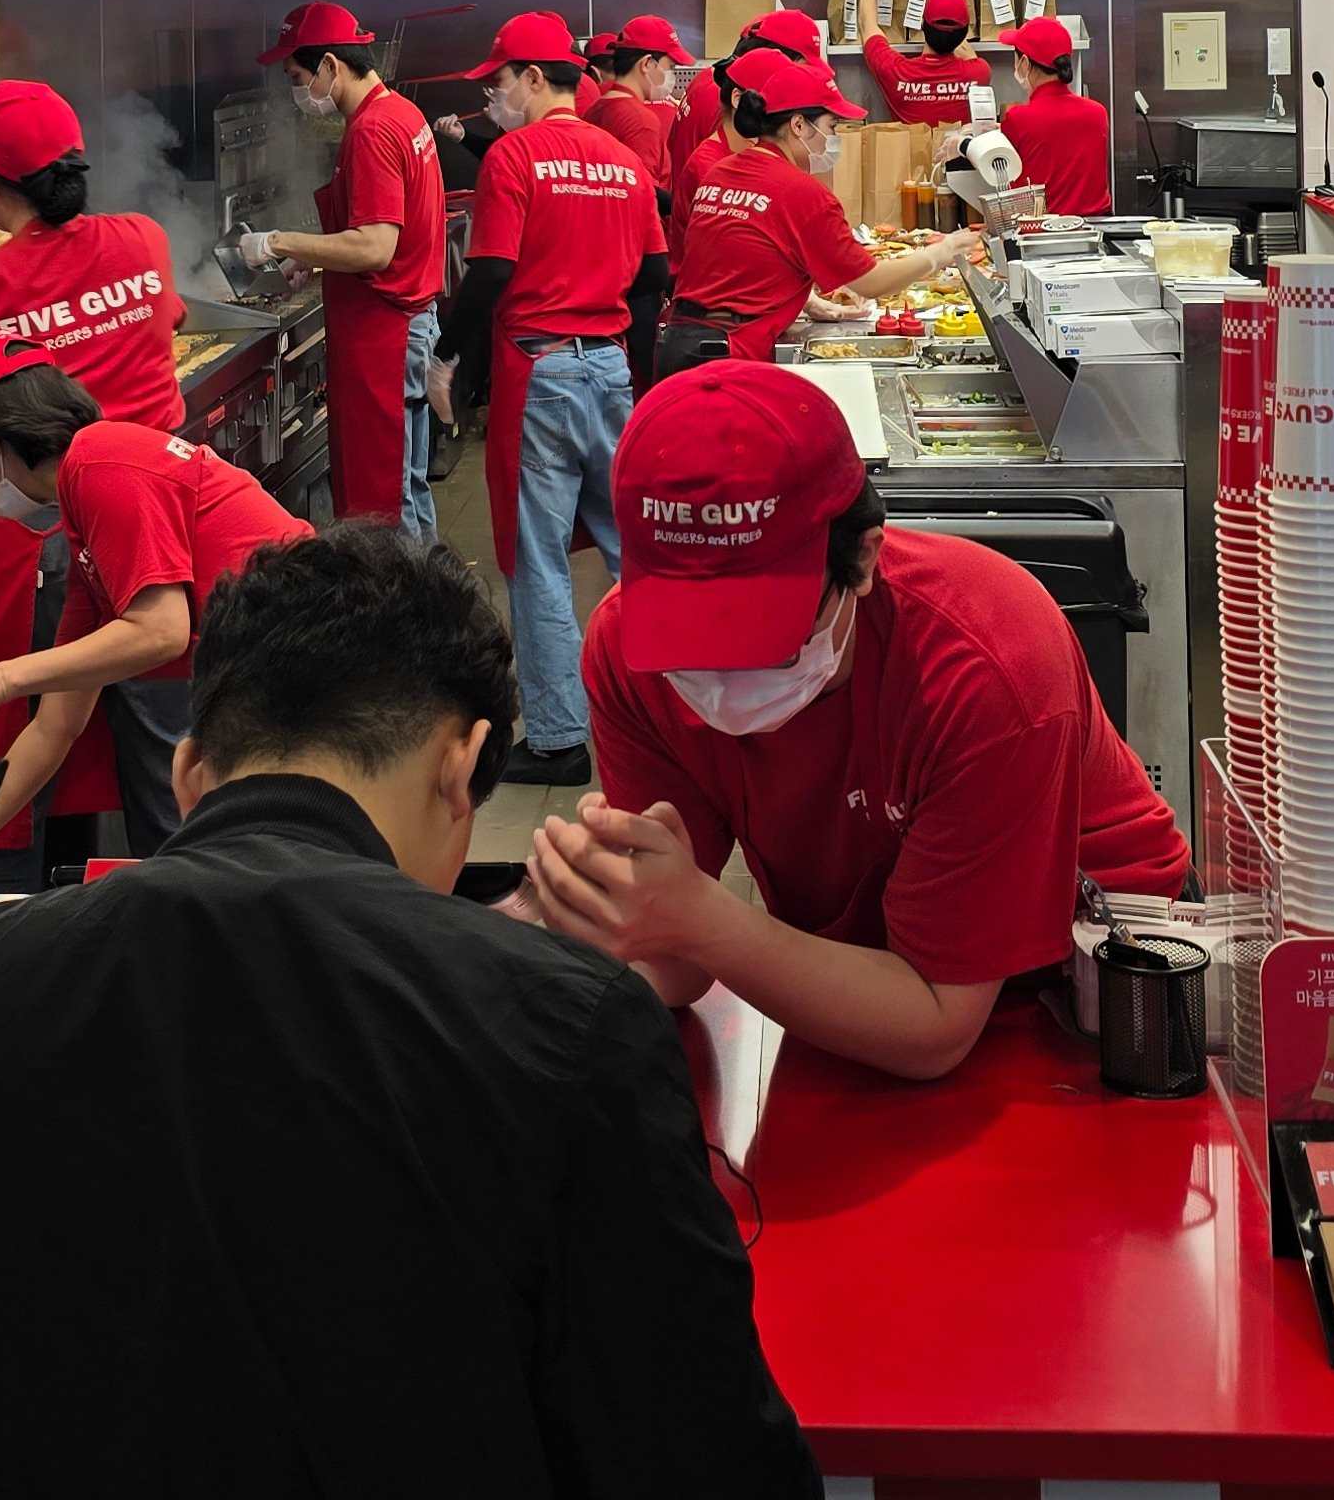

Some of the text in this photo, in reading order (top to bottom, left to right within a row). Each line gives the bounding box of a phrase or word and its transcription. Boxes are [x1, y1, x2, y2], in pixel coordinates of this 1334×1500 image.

[897, 81, 931, 94] FIVE
[534, 159, 637, 186] FIVE GUYS
[722, 188, 772, 213] GUYS
[80, 270, 162, 315] GUYS
[1054, 282, 1080, 291] Medicom
[45, 304, 154, 350] RGERS and FRIES
[1069, 325, 1097, 333] Medicom
[1308, 387, 1329, 398] and
[1276, 401, 1334, 424] GUYS
[642, 495, 779, 524] FIVE GUYS
